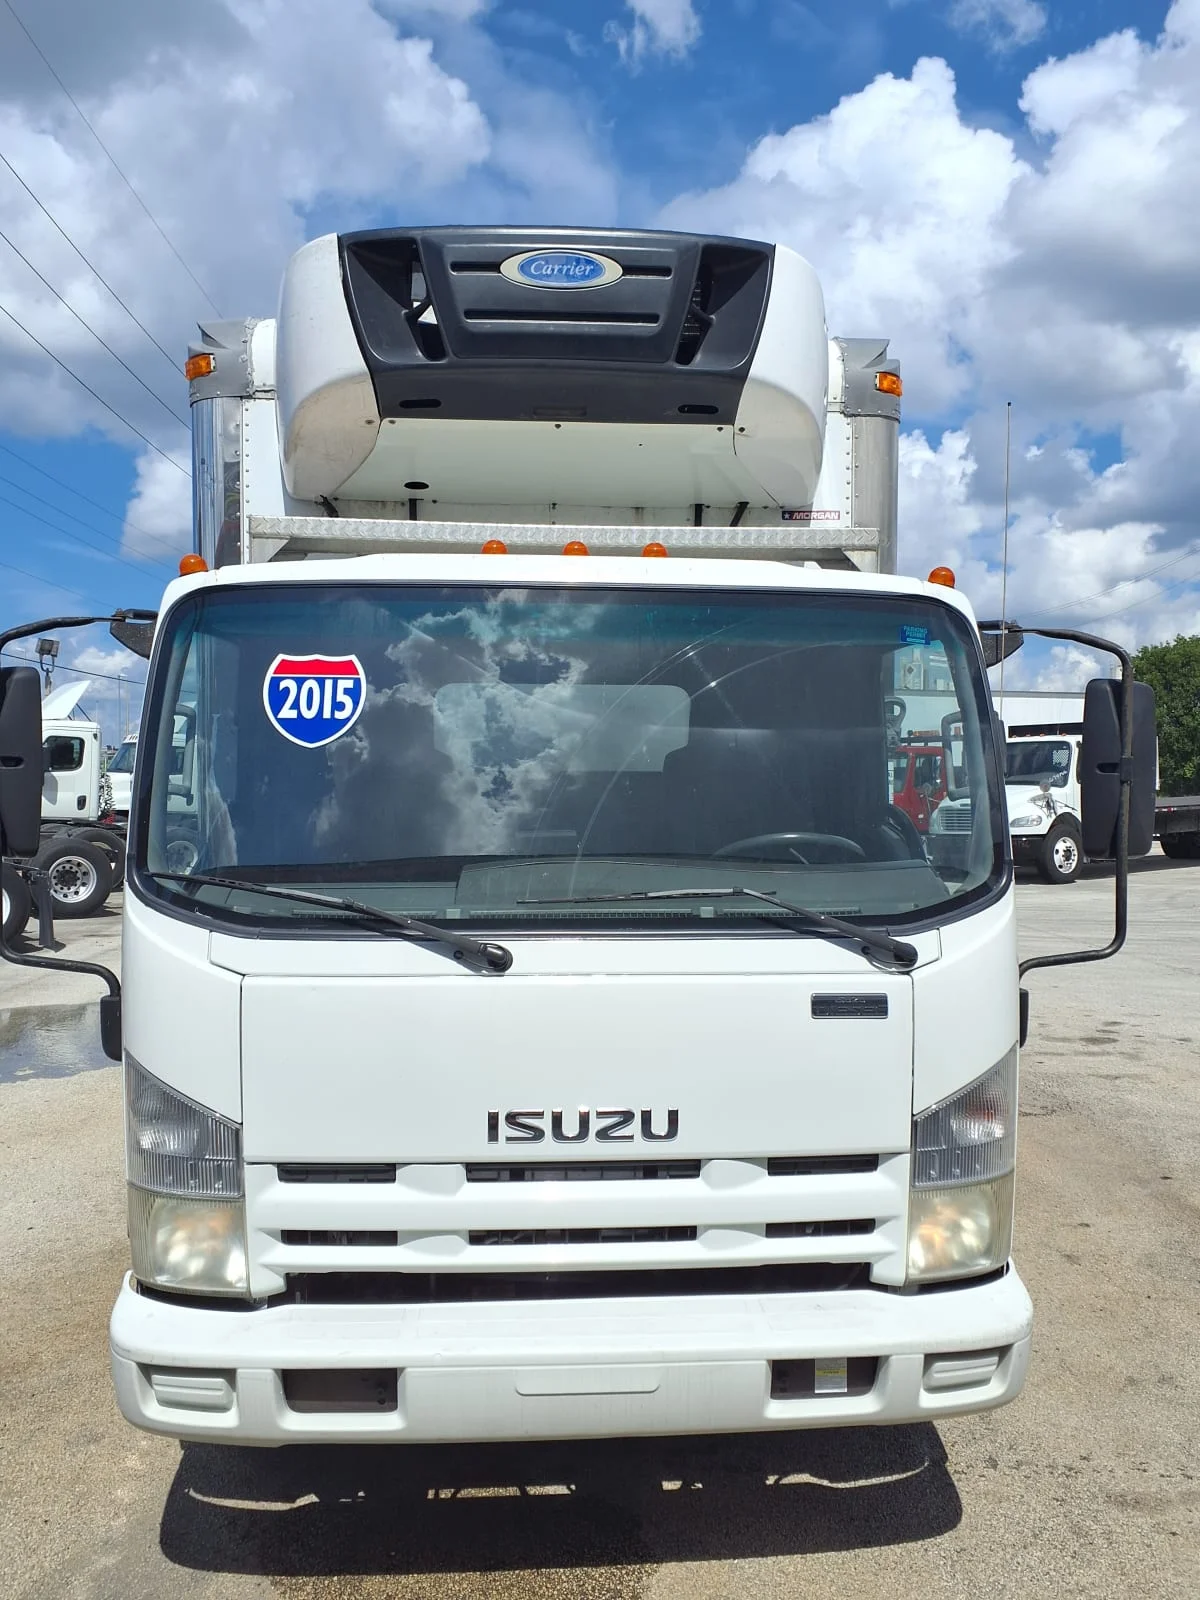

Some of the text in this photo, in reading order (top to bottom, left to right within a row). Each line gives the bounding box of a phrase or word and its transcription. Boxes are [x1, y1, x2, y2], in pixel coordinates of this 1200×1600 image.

[530, 260, 594, 276] Carrier
[792, 511, 839, 520] MORGAN
[276, 678, 354, 720] 2015
[487, 1106, 679, 1144] ISUZU
